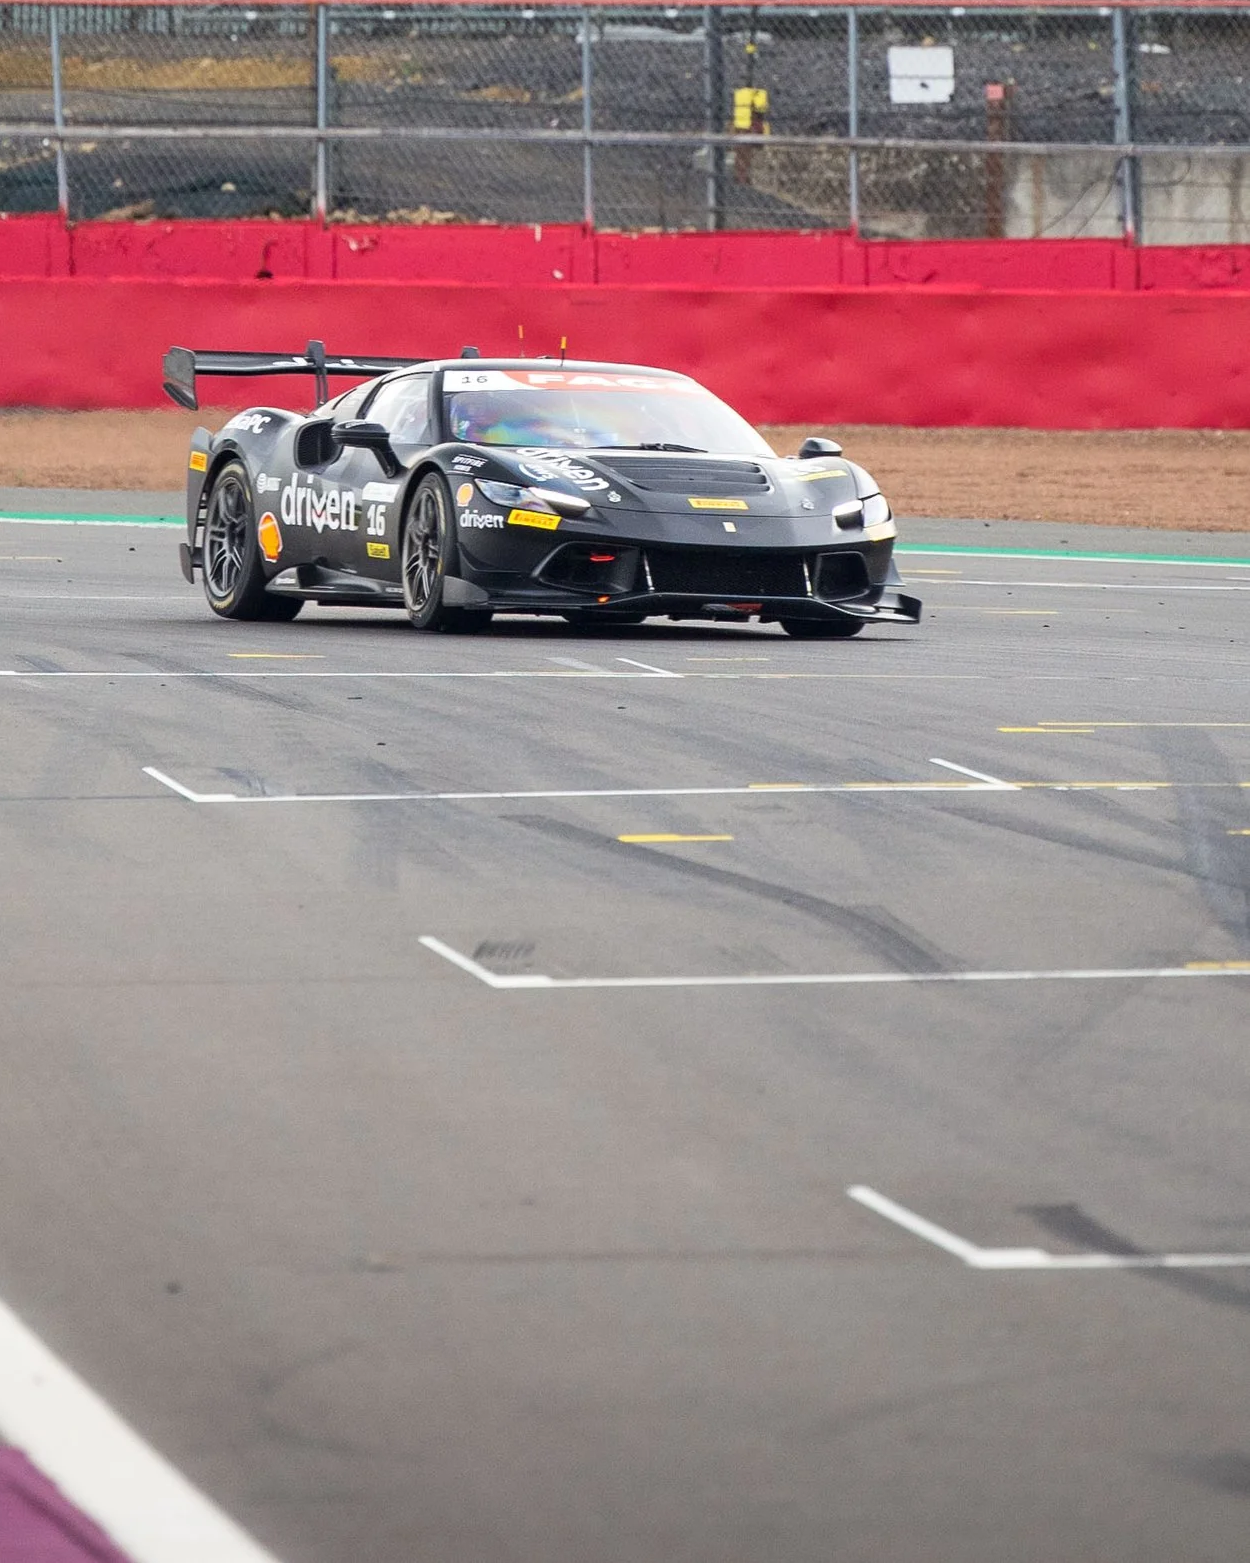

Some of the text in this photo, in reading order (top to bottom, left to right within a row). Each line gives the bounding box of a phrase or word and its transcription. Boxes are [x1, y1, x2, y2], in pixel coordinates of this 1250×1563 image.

[280, 472, 359, 534] driven
[366, 503, 386, 536] 16
[459, 509, 504, 529] driven
